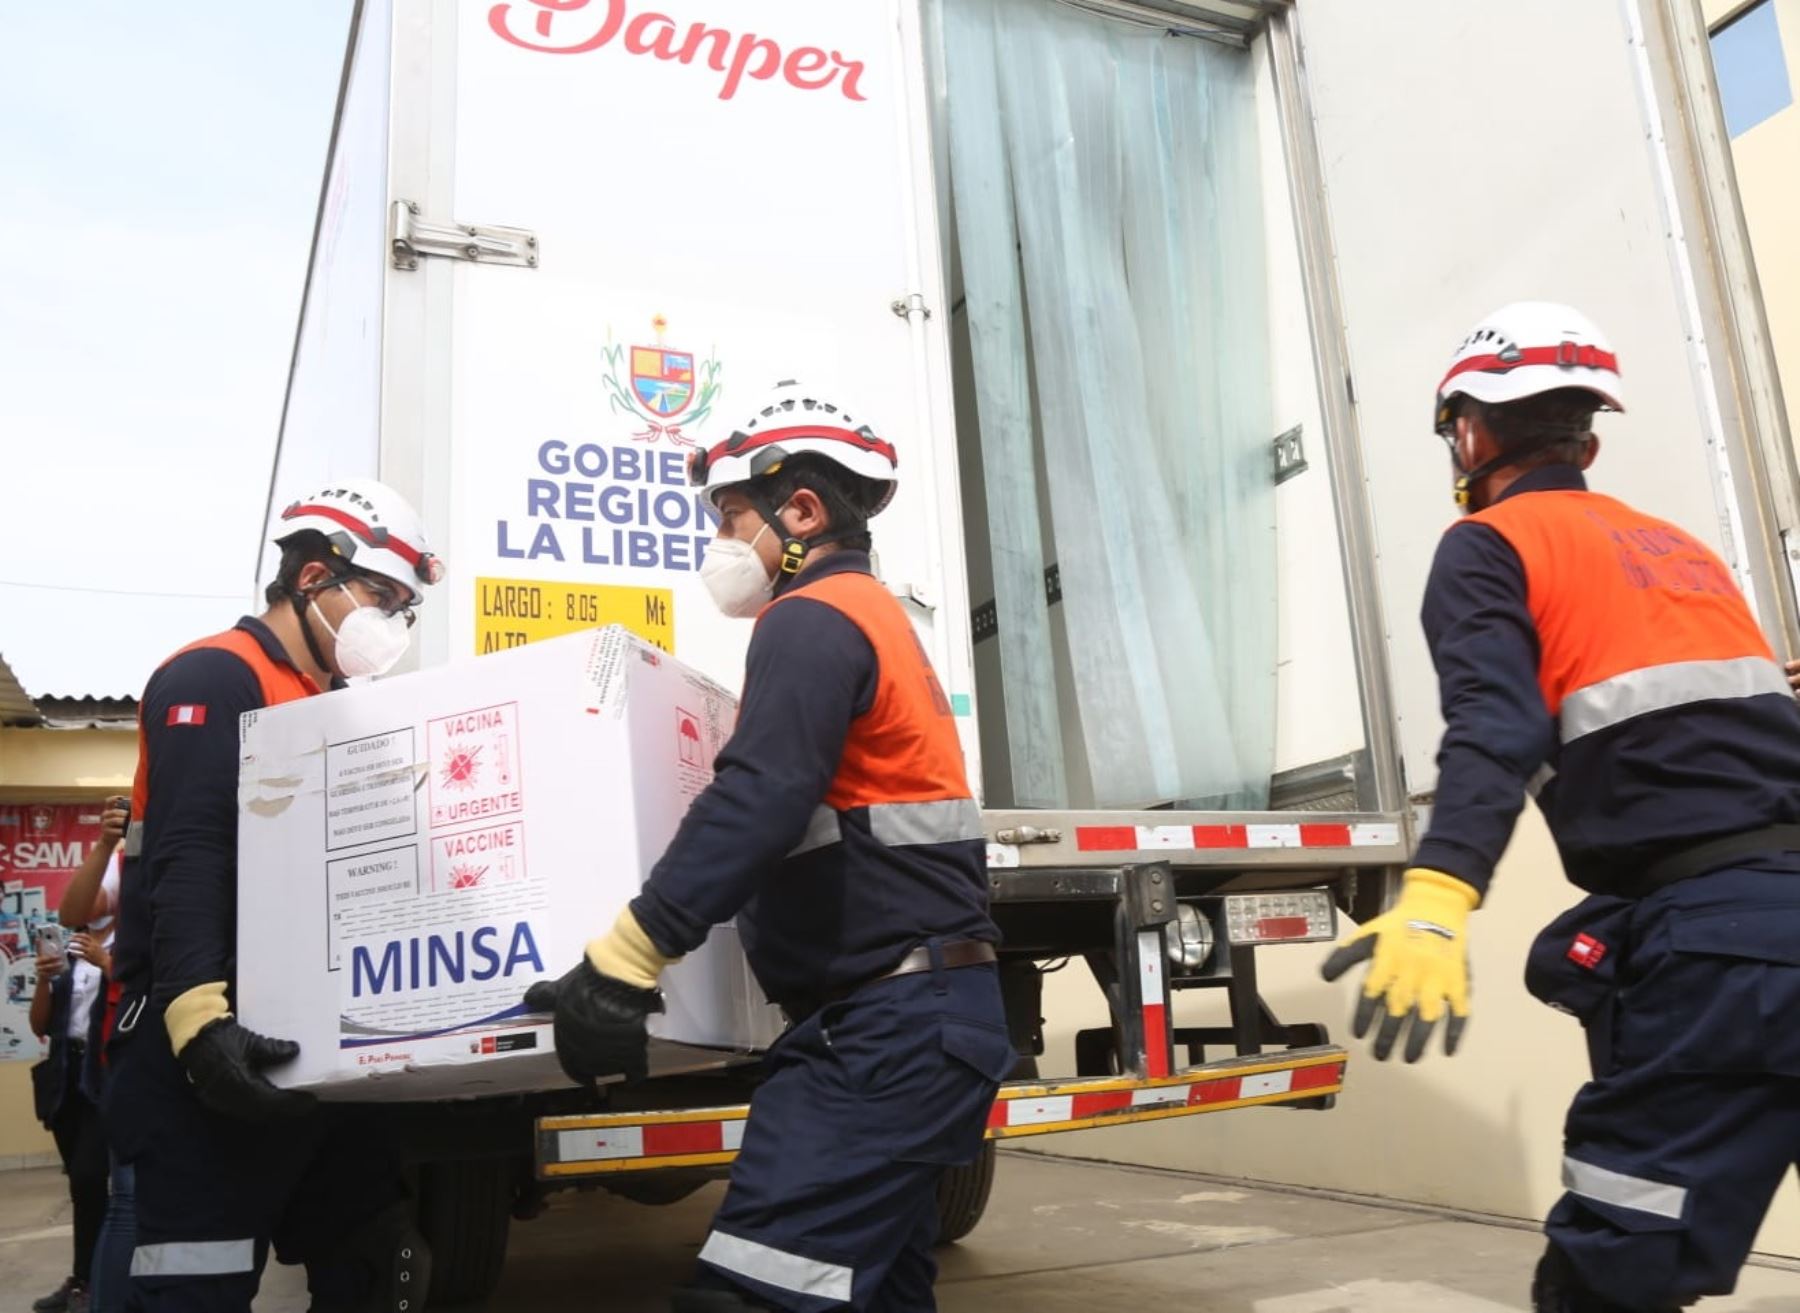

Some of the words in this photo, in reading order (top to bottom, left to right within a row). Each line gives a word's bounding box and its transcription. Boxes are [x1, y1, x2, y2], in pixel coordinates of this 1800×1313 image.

[538, 440, 686, 486] GOBIE
[528, 479, 721, 531] REGION
[497, 520, 566, 562] LA
[567, 594, 598, 622] 8.05
[646, 595, 666, 625] Mt
[445, 711, 503, 737] VACINA
[449, 792, 520, 819] URGENTE
[445, 829, 514, 858] VACCINE
[347, 861, 393, 878] WARNING
[353, 921, 545, 997] MINSA
